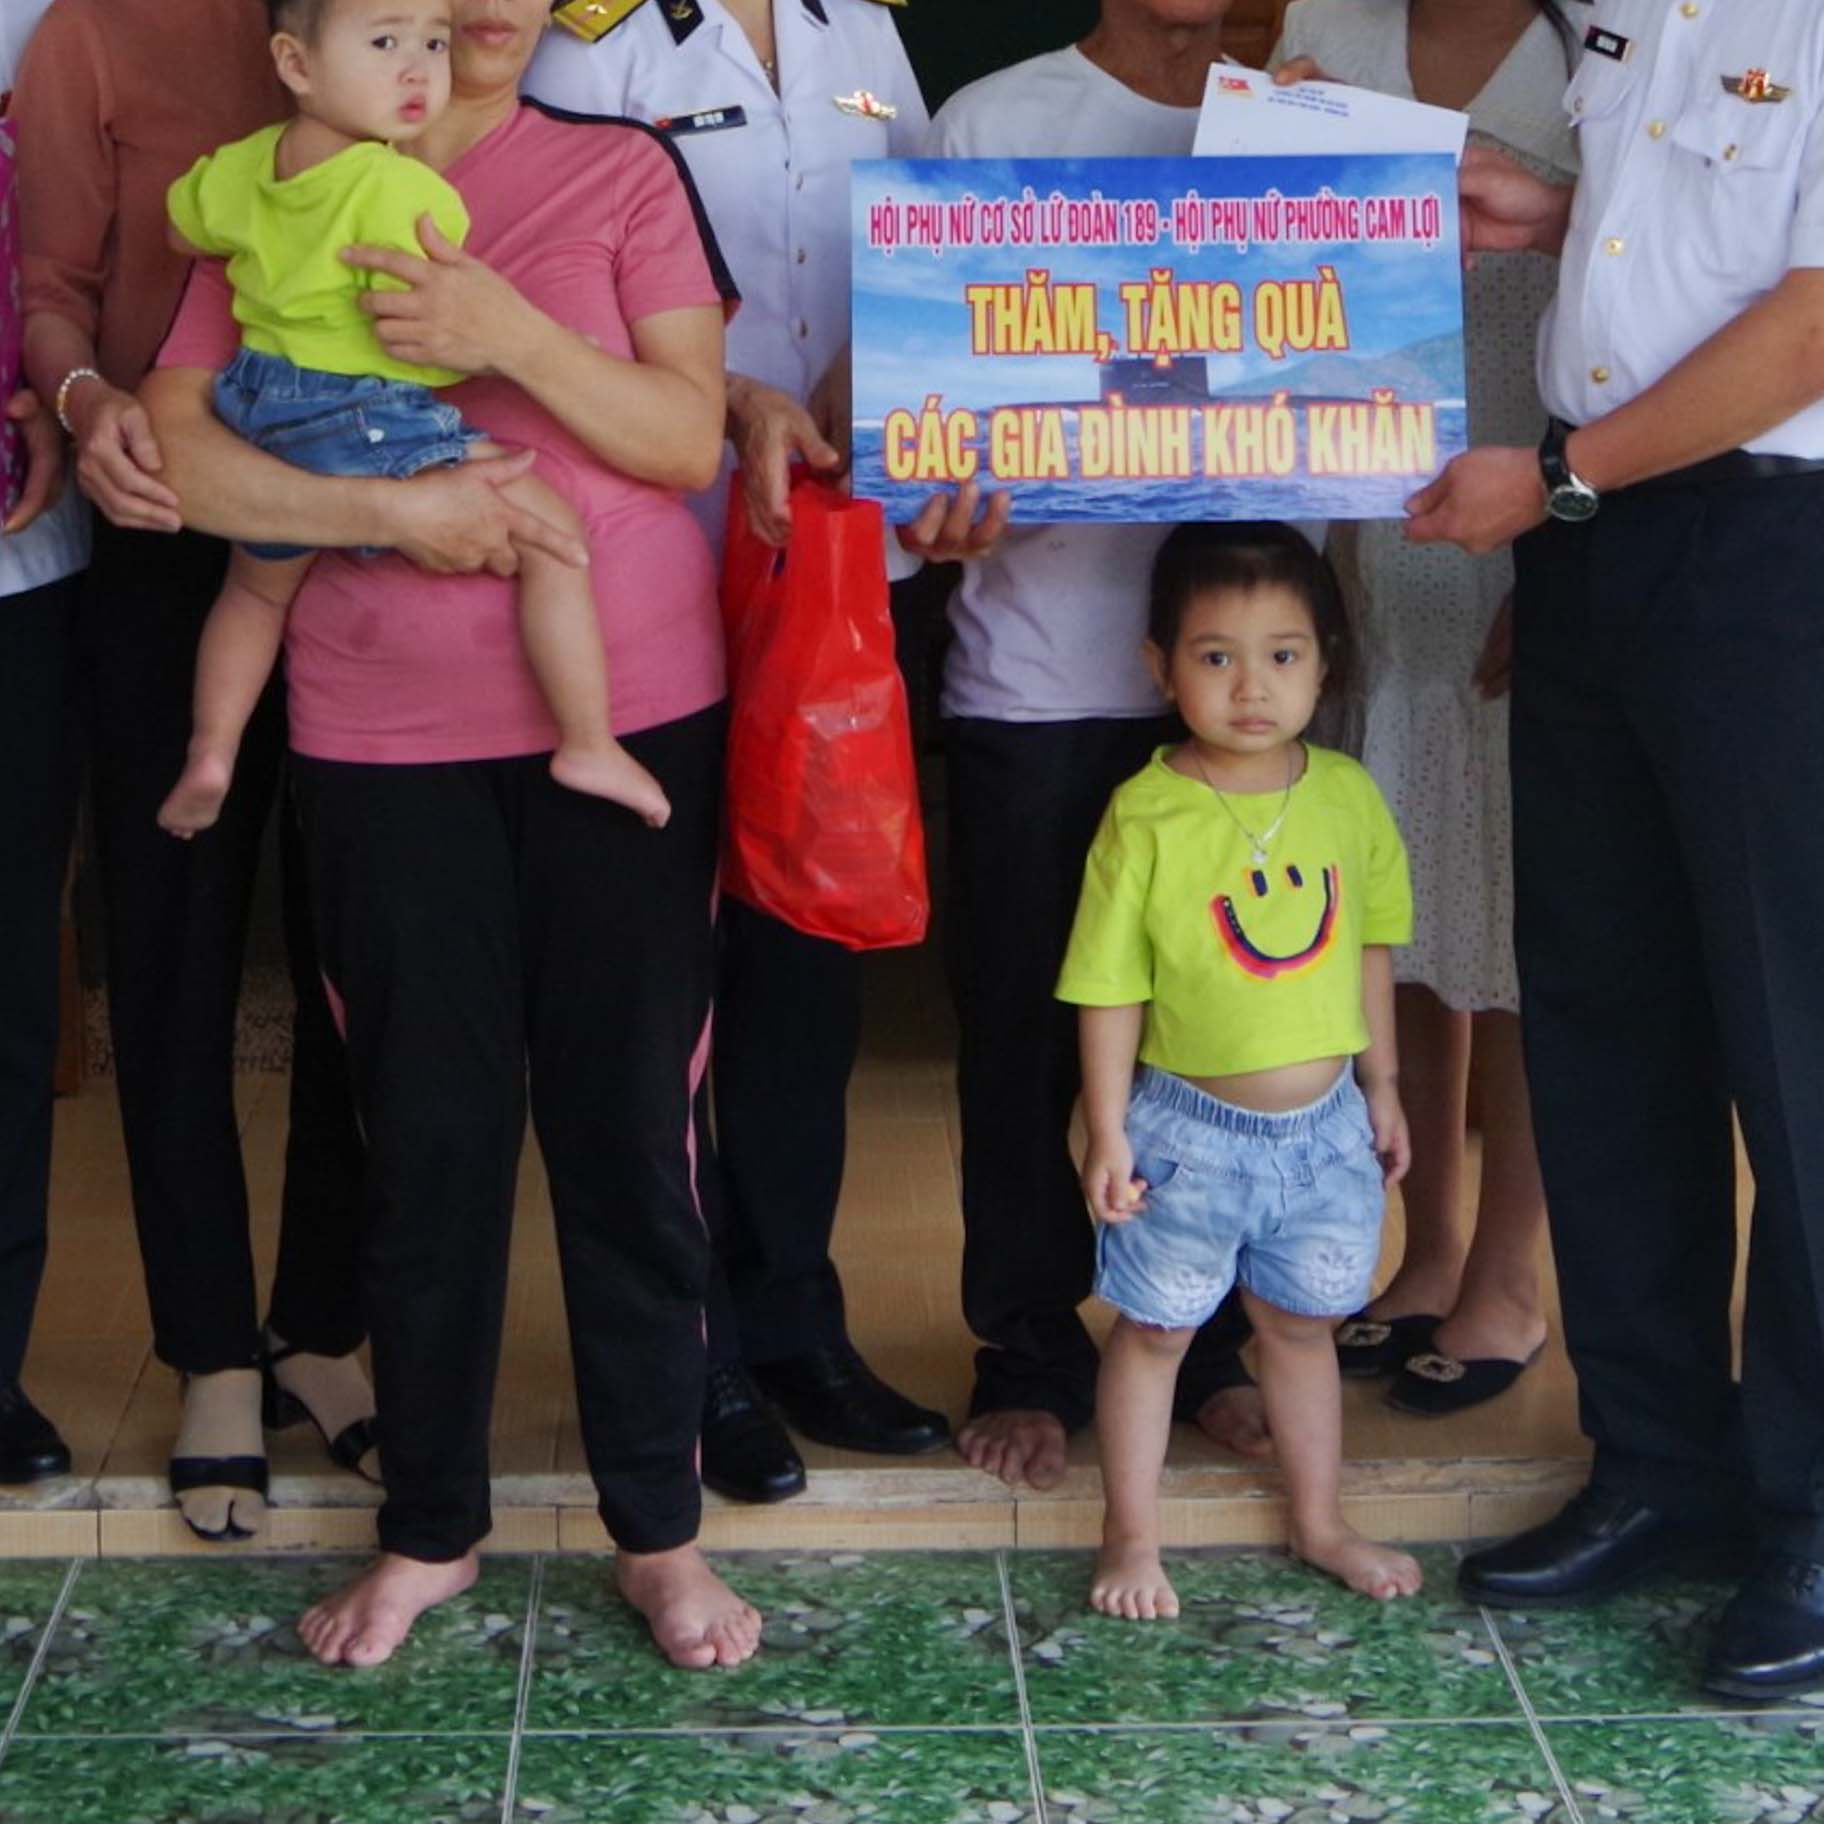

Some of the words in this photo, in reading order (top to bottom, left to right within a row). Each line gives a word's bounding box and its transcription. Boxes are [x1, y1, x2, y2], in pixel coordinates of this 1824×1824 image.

[870, 195, 901, 254] HỘI
[906, 204, 943, 254] PHỤ
[980, 198, 1007, 244] CƠ
[1010, 189, 1037, 244] SỞ
[1067, 193, 1118, 244] ĐOÀN
[1121, 202, 1157, 244] 189
[1175, 191, 1206, 251] HỘI
[1211, 201, 1248, 251] PHỤ
[1284, 189, 1360, 241] PHƯỜNG
[1364, 199, 1407, 240] CAM
[1411, 195, 1441, 248] LỢI
[966, 269, 1118, 364] THĂM,
[1120, 267, 1243, 367] TẶNG
[1254, 265, 1350, 359] QUÀ
[884, 394, 977, 479] CÁC
[990, 405, 1069, 479] GIA
[1079, 392, 1190, 477] ĐÌNH
[1202, 389, 1296, 477] KHÓ
[1307, 387, 1435, 476] KHĂN
